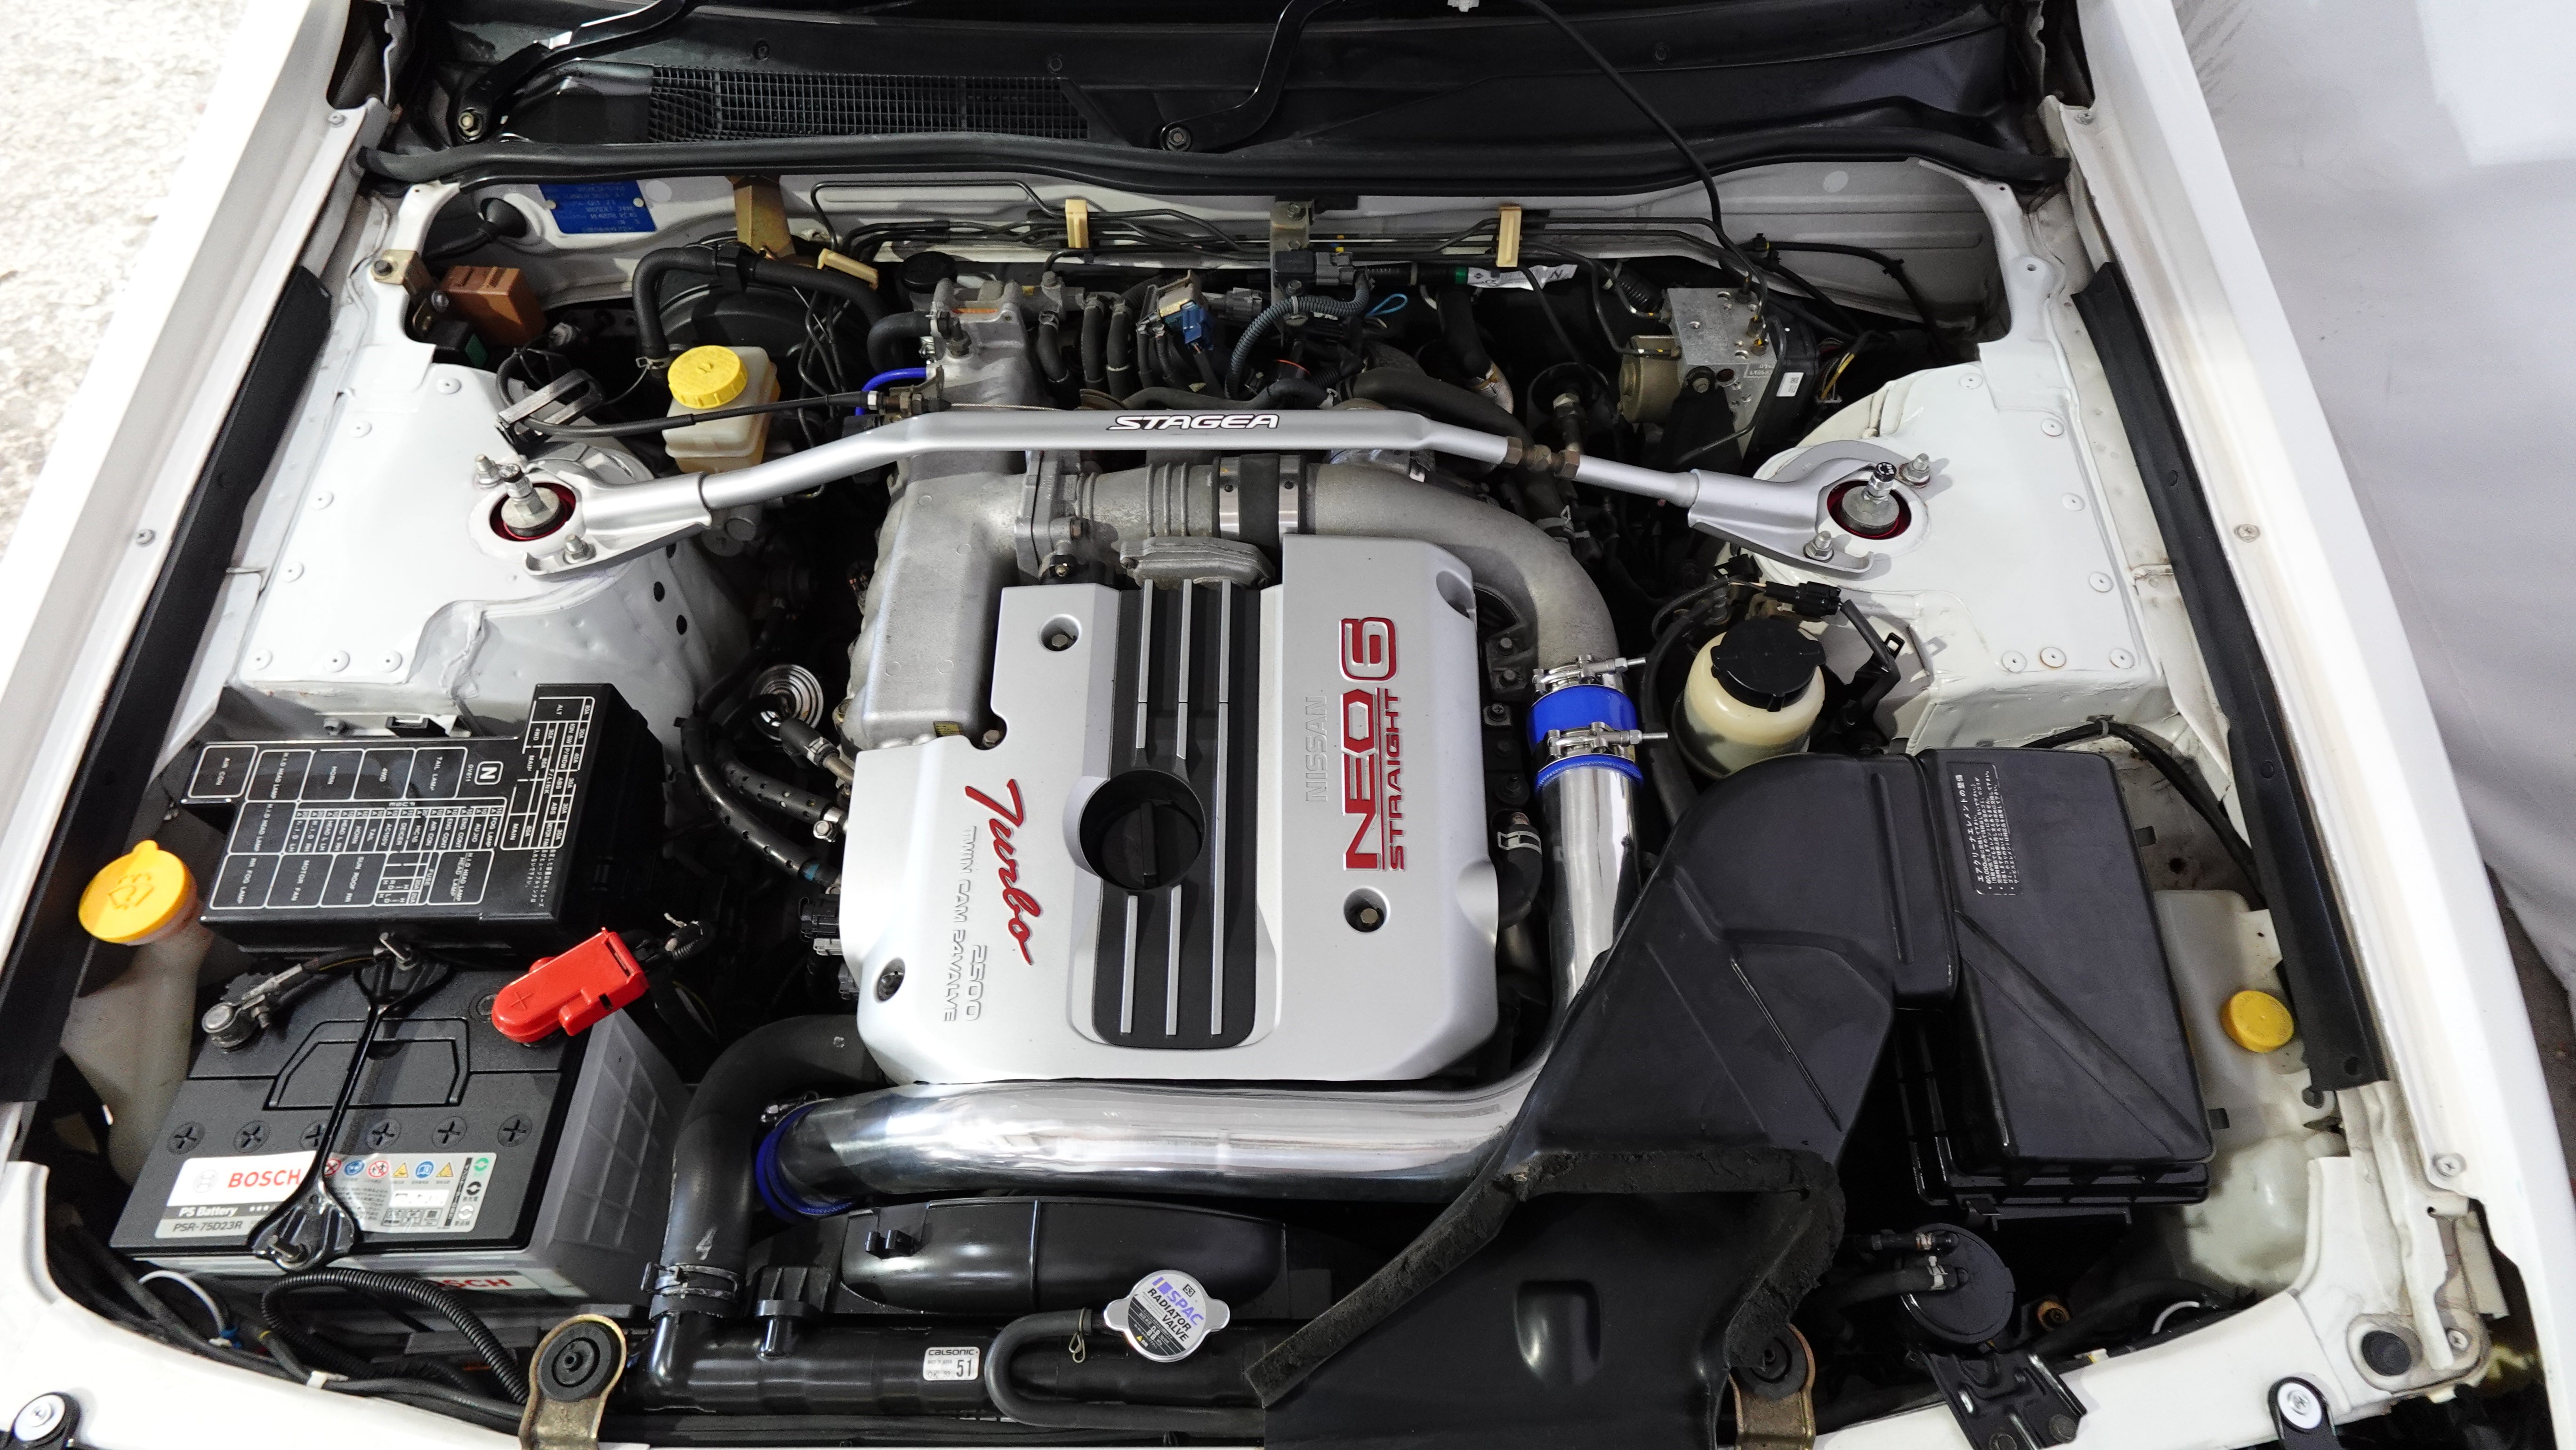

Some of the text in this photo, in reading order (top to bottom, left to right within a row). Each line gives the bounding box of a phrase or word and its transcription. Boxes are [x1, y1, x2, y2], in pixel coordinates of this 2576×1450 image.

[1106, 414, 1279, 430] STAGEA
[532, 728, 541, 741] 4WD
[565, 723, 576, 744] IGN SW
[1306, 695, 1328, 802] NISSAN
[1339, 617, 1400, 871] NEO 6
[527, 755, 535, 771] MAIN
[561, 748, 570, 769] P/WDW
[215, 757, 231, 786] AIR CON
[274, 767, 284, 783] HEAD
[327, 766, 338, 785] HORN
[379, 767, 388, 782] 4WD
[430, 757, 443, 791] TAIL LAMP
[1385, 688, 1406, 871] STRAIGHT
[270, 784, 280, 799] LAMP
[258, 819, 268, 835] HEAD
[324, 820, 333, 836] HEAD
[339, 820, 349, 836] HEAD
[351, 826, 362, 844] HORN
[367, 829, 377, 842] TAIL
[396, 822, 407, 846] DEICER
[426, 821, 437, 846] AIR CON
[440, 818, 454, 849] ENG CONT
[455, 818, 468, 848] ENG CONT
[485, 817, 498, 847] FOG LAMP
[509, 823, 519, 840] MAIN
[544, 823, 553, 838] MOTOR
[1955, 774, 1984, 882] エアクリーナエレメントの整備
[253, 836, 263, 852] LAMP
[354, 856, 365, 870] SUN
[242, 870, 253, 884] FOG
[291, 860, 310, 902] MOTOR FAN
[349, 872, 359, 890] ROOF
[424, 869, 434, 886] FUSE
[451, 857, 465, 896] HEAD LAMP
[459, 869, 469, 884] HEAD
[965, 779, 1043, 966] Turbo
[237, 886, 248, 904] LAMP
[455, 885, 465, 902] LAMP
[943, 826, 977, 1022] TWIN CAM 24VALVE
[964, 945, 987, 1021] 2500
[228, 1168, 301, 1188] BOSCH
[178, 1206, 238, 1217] PS Battery
[173, 1221, 243, 1232] PSR-75D23R
[1184, 1286, 1194, 1297] 53
[1148, 1288, 1192, 1332] RADIATOR
[1162, 1314, 1189, 1342] VALVE
[956, 1358, 972, 1378] 51
